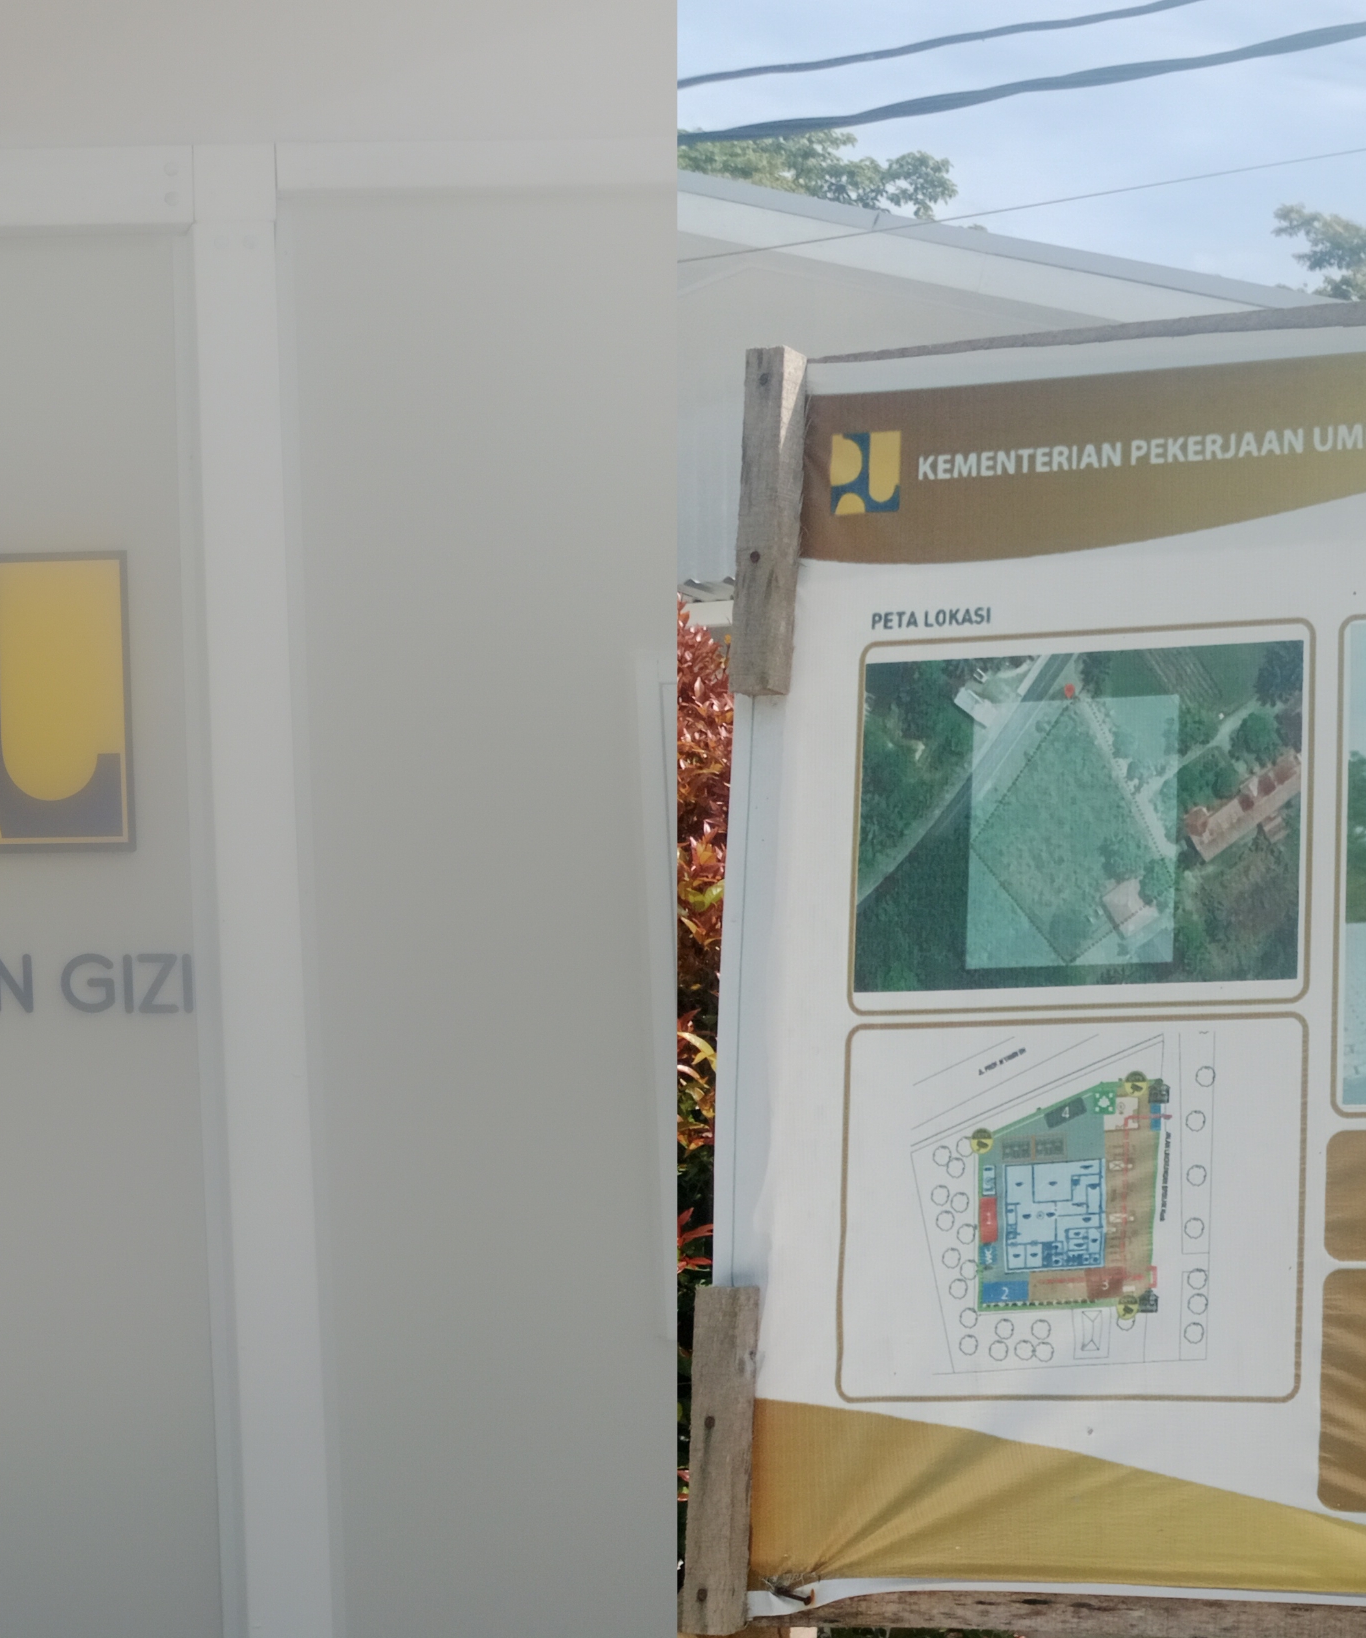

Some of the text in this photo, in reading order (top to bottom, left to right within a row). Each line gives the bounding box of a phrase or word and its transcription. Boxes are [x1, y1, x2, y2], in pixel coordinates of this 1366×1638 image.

[917, 442, 1122, 480] KEMENTERIAN
[1130, 428, 1304, 465] PEKERJAAN
[871, 606, 992, 630] PETA LOKASI
[60, 953, 195, 1015] GIZI
[1061, 1106, 1070, 1118] 4
[1001, 1287, 1009, 1300] 2
